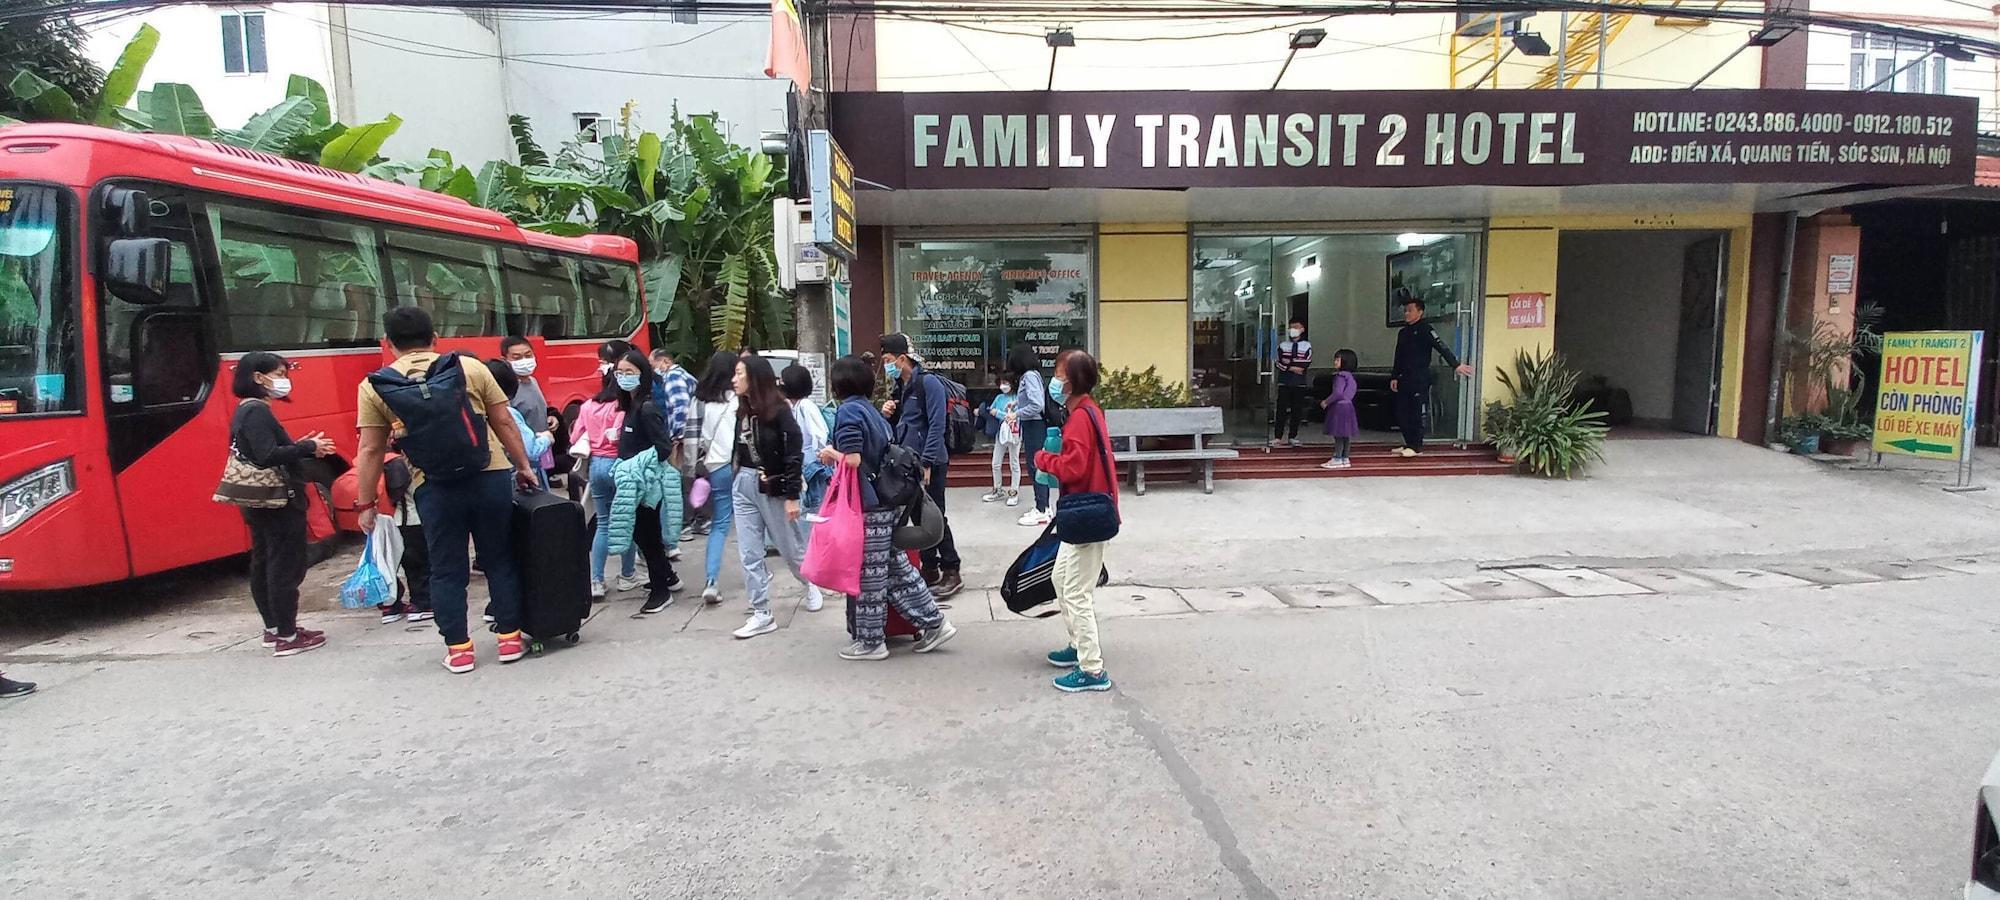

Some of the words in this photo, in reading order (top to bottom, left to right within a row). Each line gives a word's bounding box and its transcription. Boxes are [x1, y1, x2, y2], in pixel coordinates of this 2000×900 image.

[913, 114, 1117, 168] FAMILY
[1134, 113, 1366, 168] TRANSIT
[1375, 112, 1406, 166] 2
[1424, 111, 1585, 166] HOTEL
[1630, 145, 1667, 163] ADD:
[1740, 144, 1792, 165] QUANG
[1838, 141, 1868, 163] SÓC
[1928, 144, 1952, 168] NỘI
[911, 271, 945, 281] TRAVEL
[947, 271, 983, 281] AGENCY
[1049, 269, 1081, 279] OFFICE
[1887, 338, 1918, 348] FAMILY
[1921, 338, 1958, 349] TRANSIT
[1960, 338, 1966, 349] 2
[953, 360, 976, 370] TOUR
[1885, 356, 1965, 387] HOTEL
[1880, 388, 1909, 411] CÒN
[1912, 390, 1962, 416] PHÒNG
[1915, 421, 1931, 436] XE
[1933, 421, 1960, 438] MÁY
